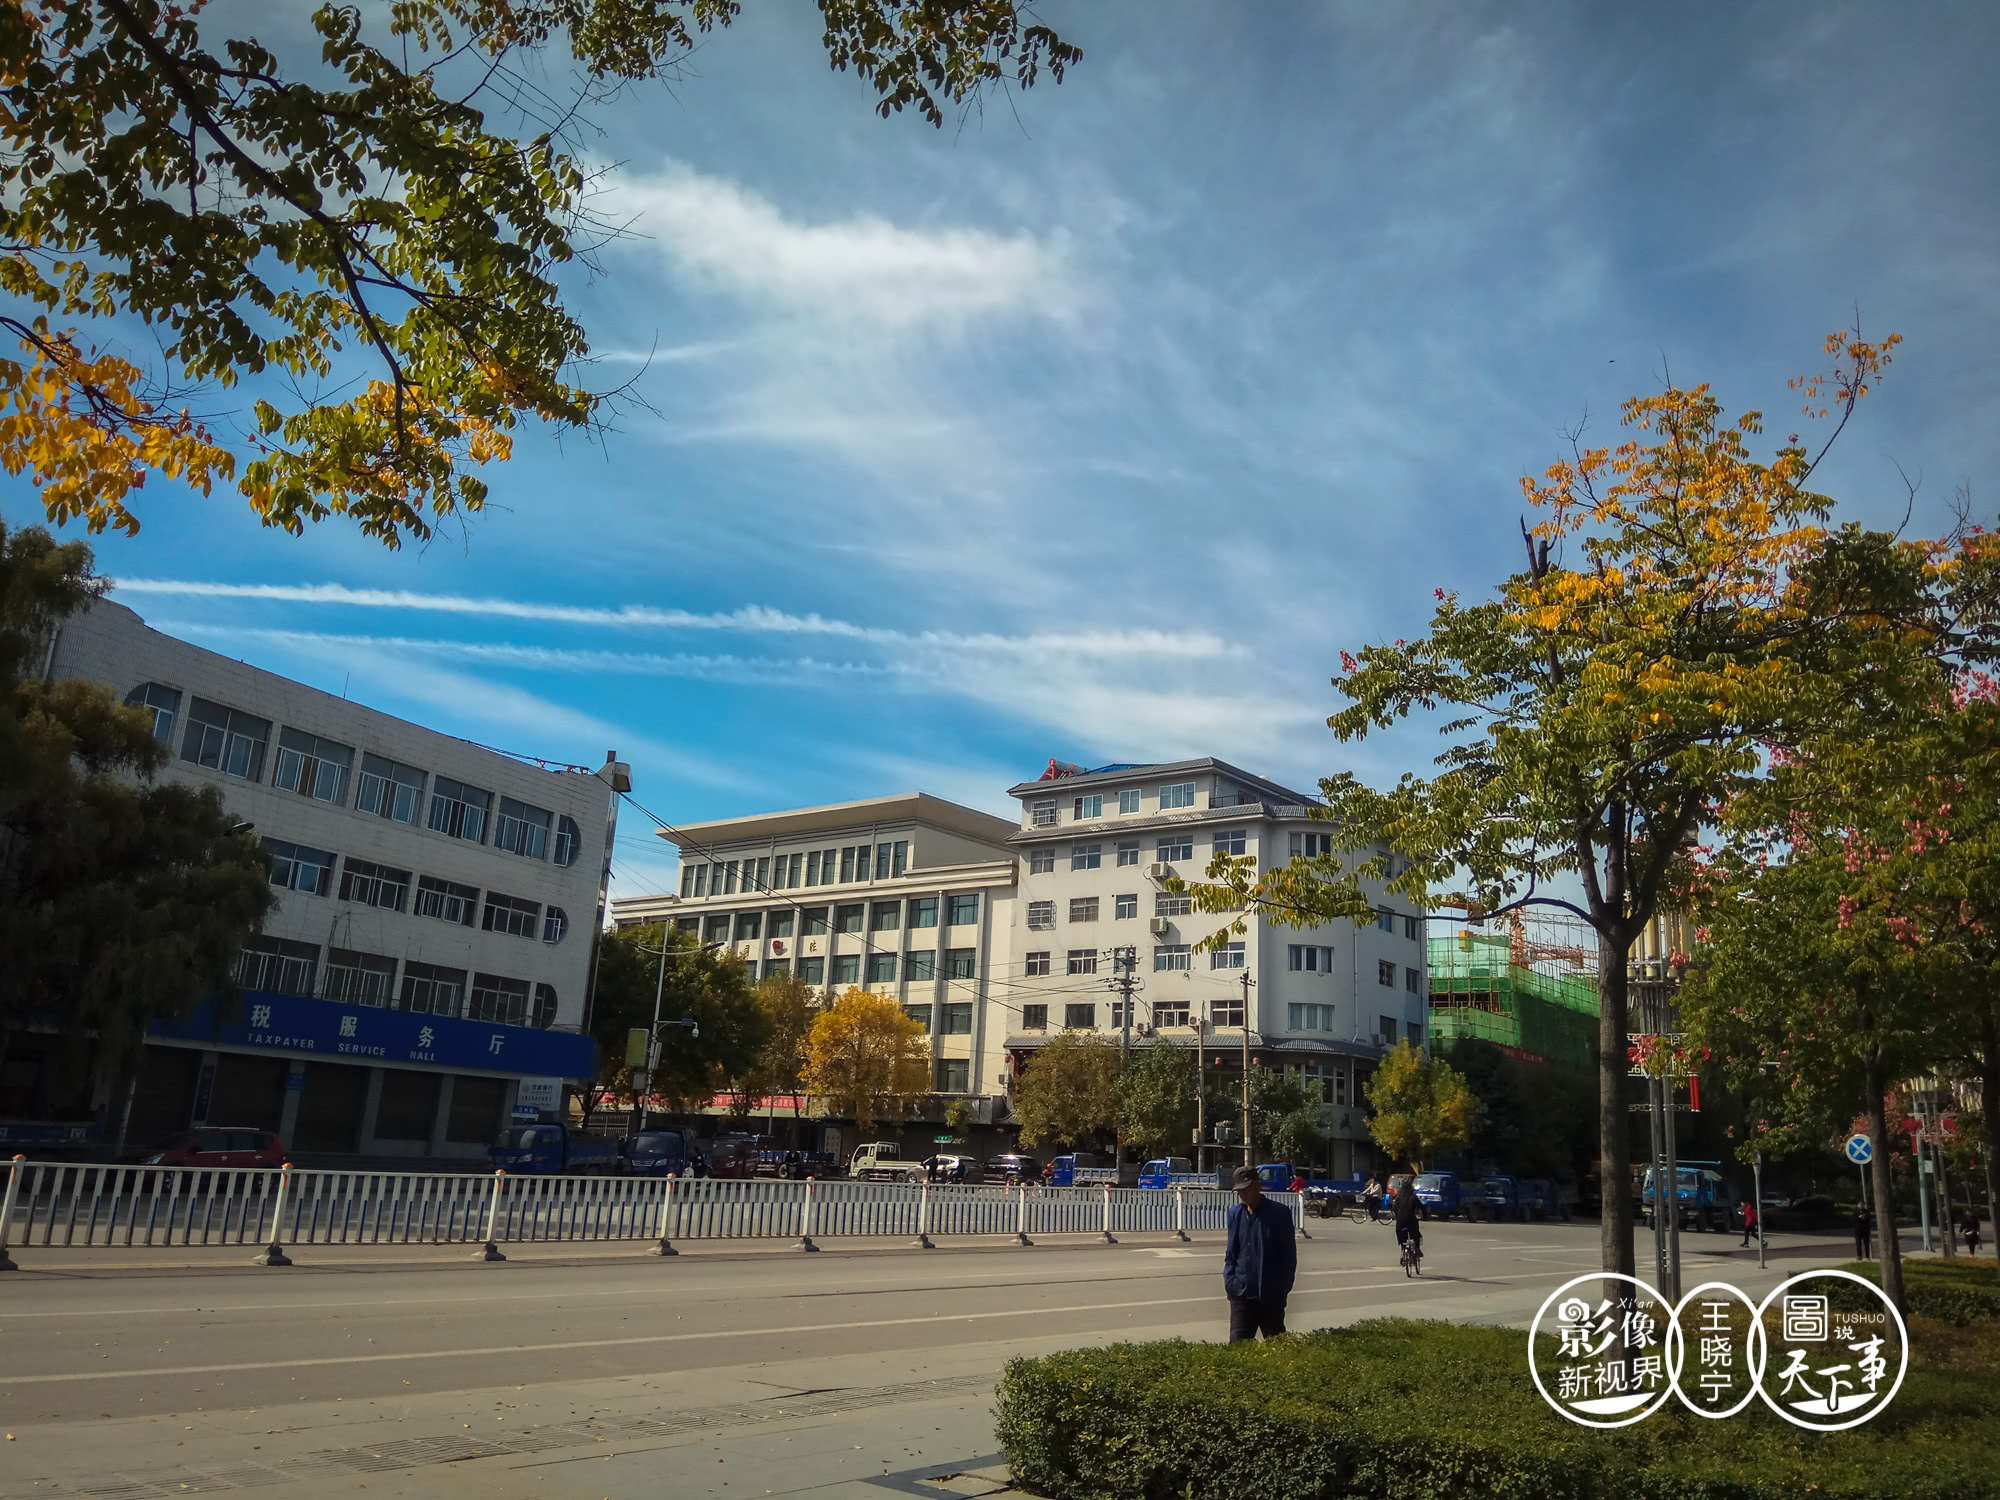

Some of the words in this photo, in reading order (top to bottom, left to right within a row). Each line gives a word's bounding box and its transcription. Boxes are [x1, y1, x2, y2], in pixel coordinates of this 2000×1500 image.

[248, 1032, 315, 1049] TAXPAYER
[337, 1042, 386, 1056] SERVICE
[409, 1050, 436, 1062] HALL
